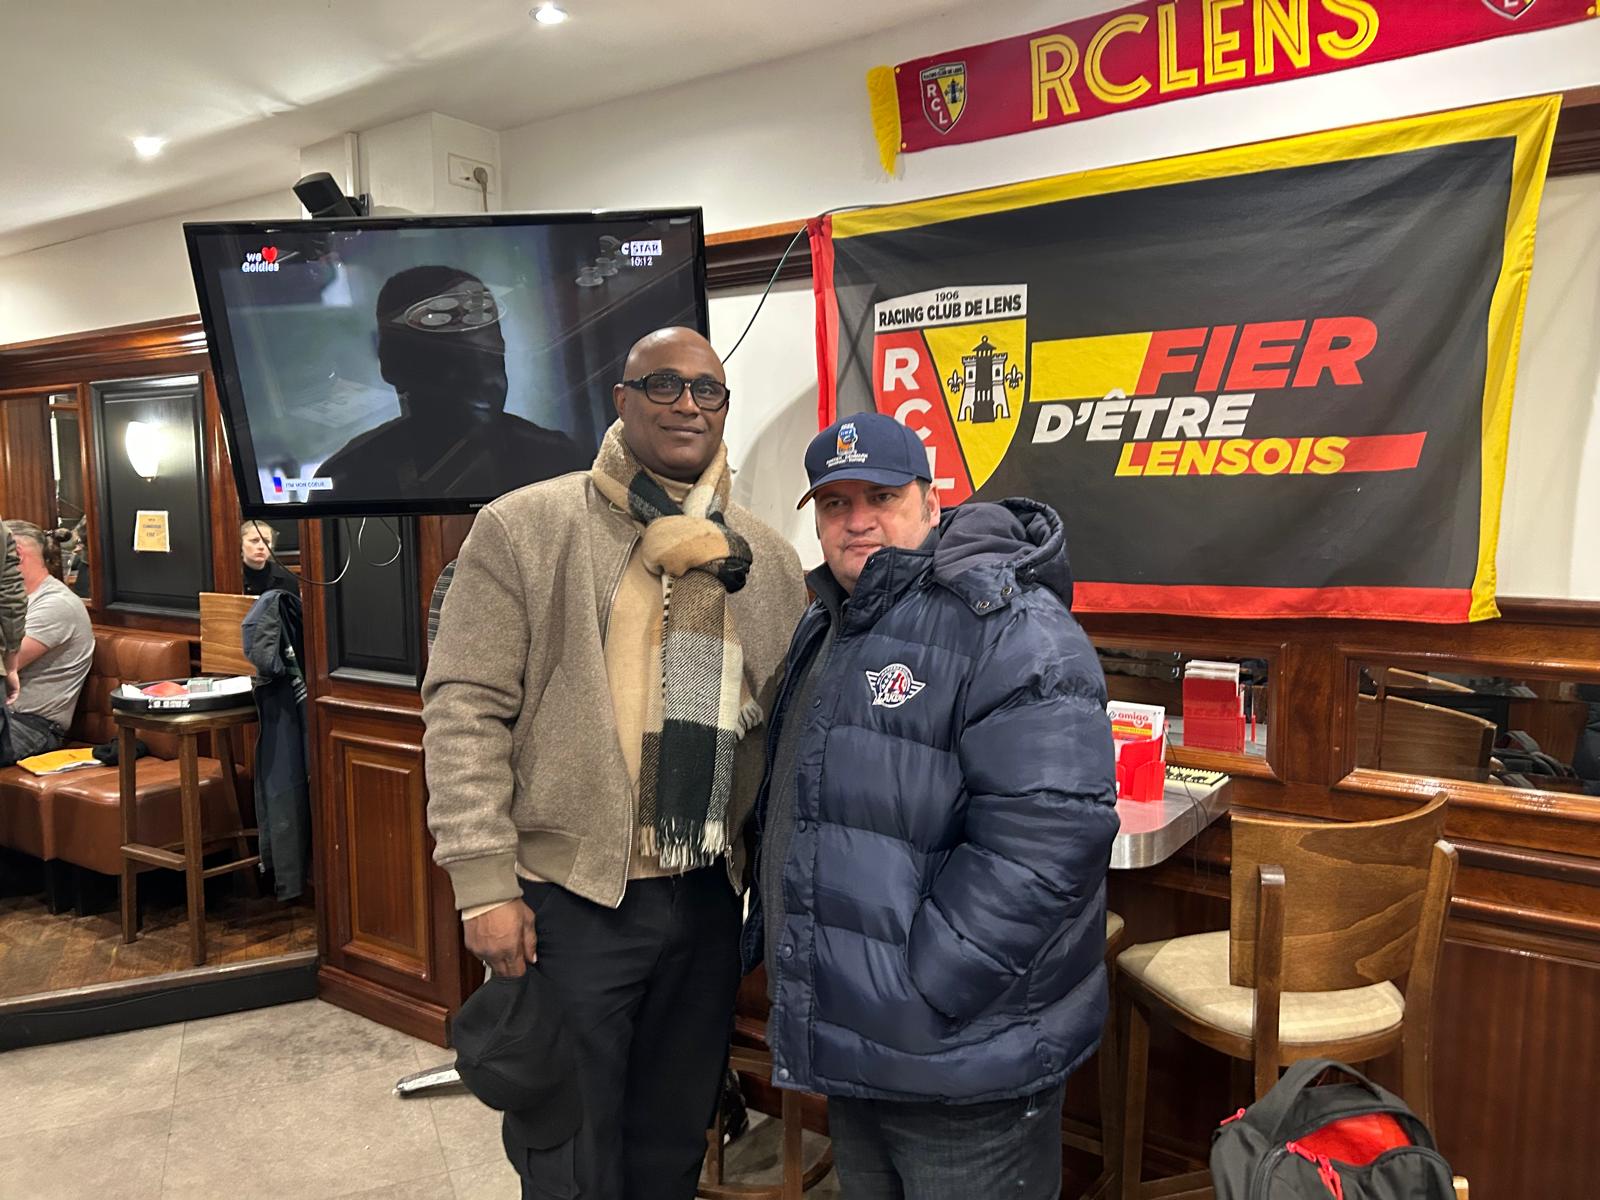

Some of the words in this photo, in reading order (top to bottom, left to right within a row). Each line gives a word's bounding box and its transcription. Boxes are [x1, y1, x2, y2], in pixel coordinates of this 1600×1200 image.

[878, 305, 924, 327] RACING
[926, 301, 962, 321] CLUB
[964, 299, 983, 317] DE
[985, 293, 1022, 315] LENS
[935, 290, 960, 302] 1906
[1133, 316, 1378, 395] FIER
[1031, 388, 1256, 443] D'ÊTRE
[1114, 436, 1351, 477] LENSOIS
[1118, 711, 1149, 726] amigo
